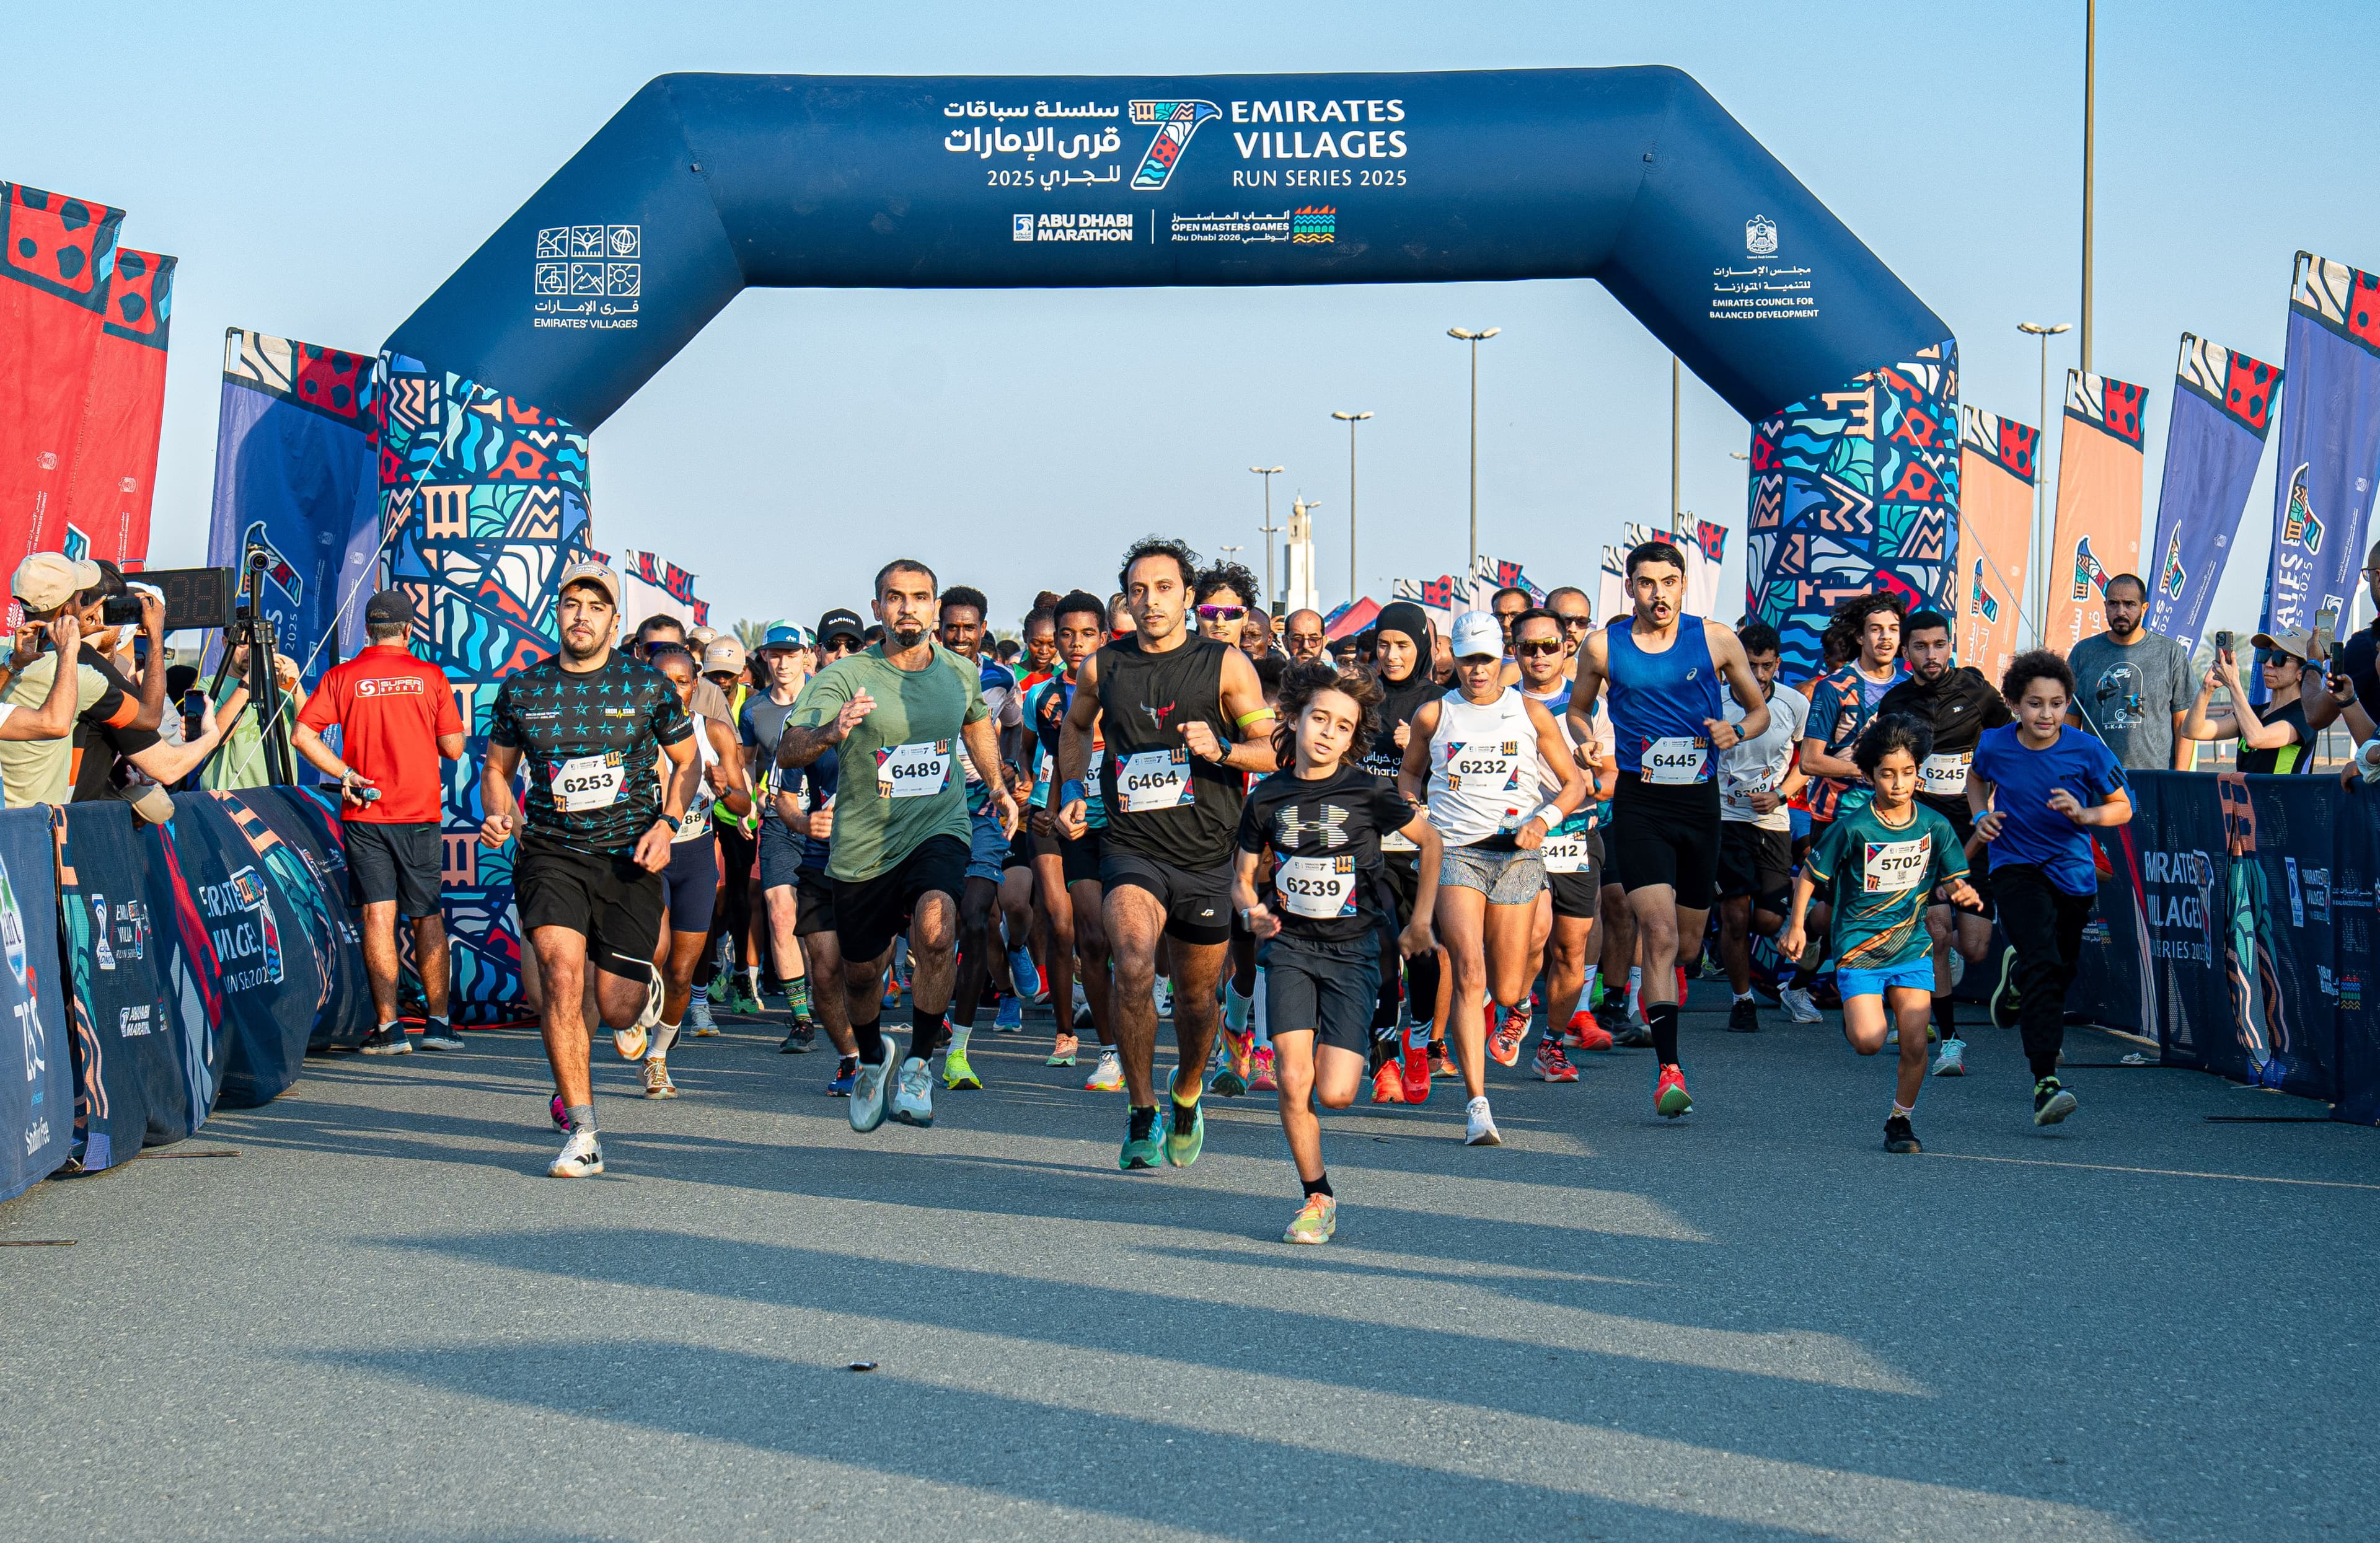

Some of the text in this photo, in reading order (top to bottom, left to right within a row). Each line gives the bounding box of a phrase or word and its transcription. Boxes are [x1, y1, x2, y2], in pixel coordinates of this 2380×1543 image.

[944, 100, 1119, 122] سلسلة سباقات
[1231, 99, 1405, 123] EMIRATES
[945, 126, 1121, 161] قرى الإمارات
[1233, 130, 1408, 159] VILLAGES
[987, 165, 1121, 191] للجري 2025
[1233, 169, 1407, 187] RUN SERIES 2025
[1038, 214, 1133, 228] ABU DHABI
[1171, 223, 1290, 231] OPEN MASTERS GAMES
[1038, 229, 1133, 241] MARATHON
[1713, 265, 1811, 277] مجلس الإمارات
[1714, 281, 1811, 293] للتنمية المتوازنة
[534, 299, 639, 316] قرى الإمارات
[1712, 297, 1814, 307] EMIRATES COUNCIL FOR
[1709, 309, 1819, 319] BALANCED DEVELOPMENT
[534, 318, 638, 329] EMIRATES' VILLAGES
[2299, 562, 2312, 602] 2025
[828, 617, 855, 626] GARMIN
[286, 613, 298, 650] 2025
[1460, 760, 1507, 774] 6232
[1654, 754, 1696, 767] 6445
[892, 761, 940, 779] 6489
[1367, 768, 1398, 780] Kharb
[1926, 767, 1964, 779] 6245
[564, 773, 614, 793] 6253
[1128, 770, 1178, 790] 6464
[685, 813, 701, 825] 88
[1541, 844, 1578, 857] 6412
[1881, 854, 1921, 870] 5702
[1287, 877, 1340, 896] 6239
